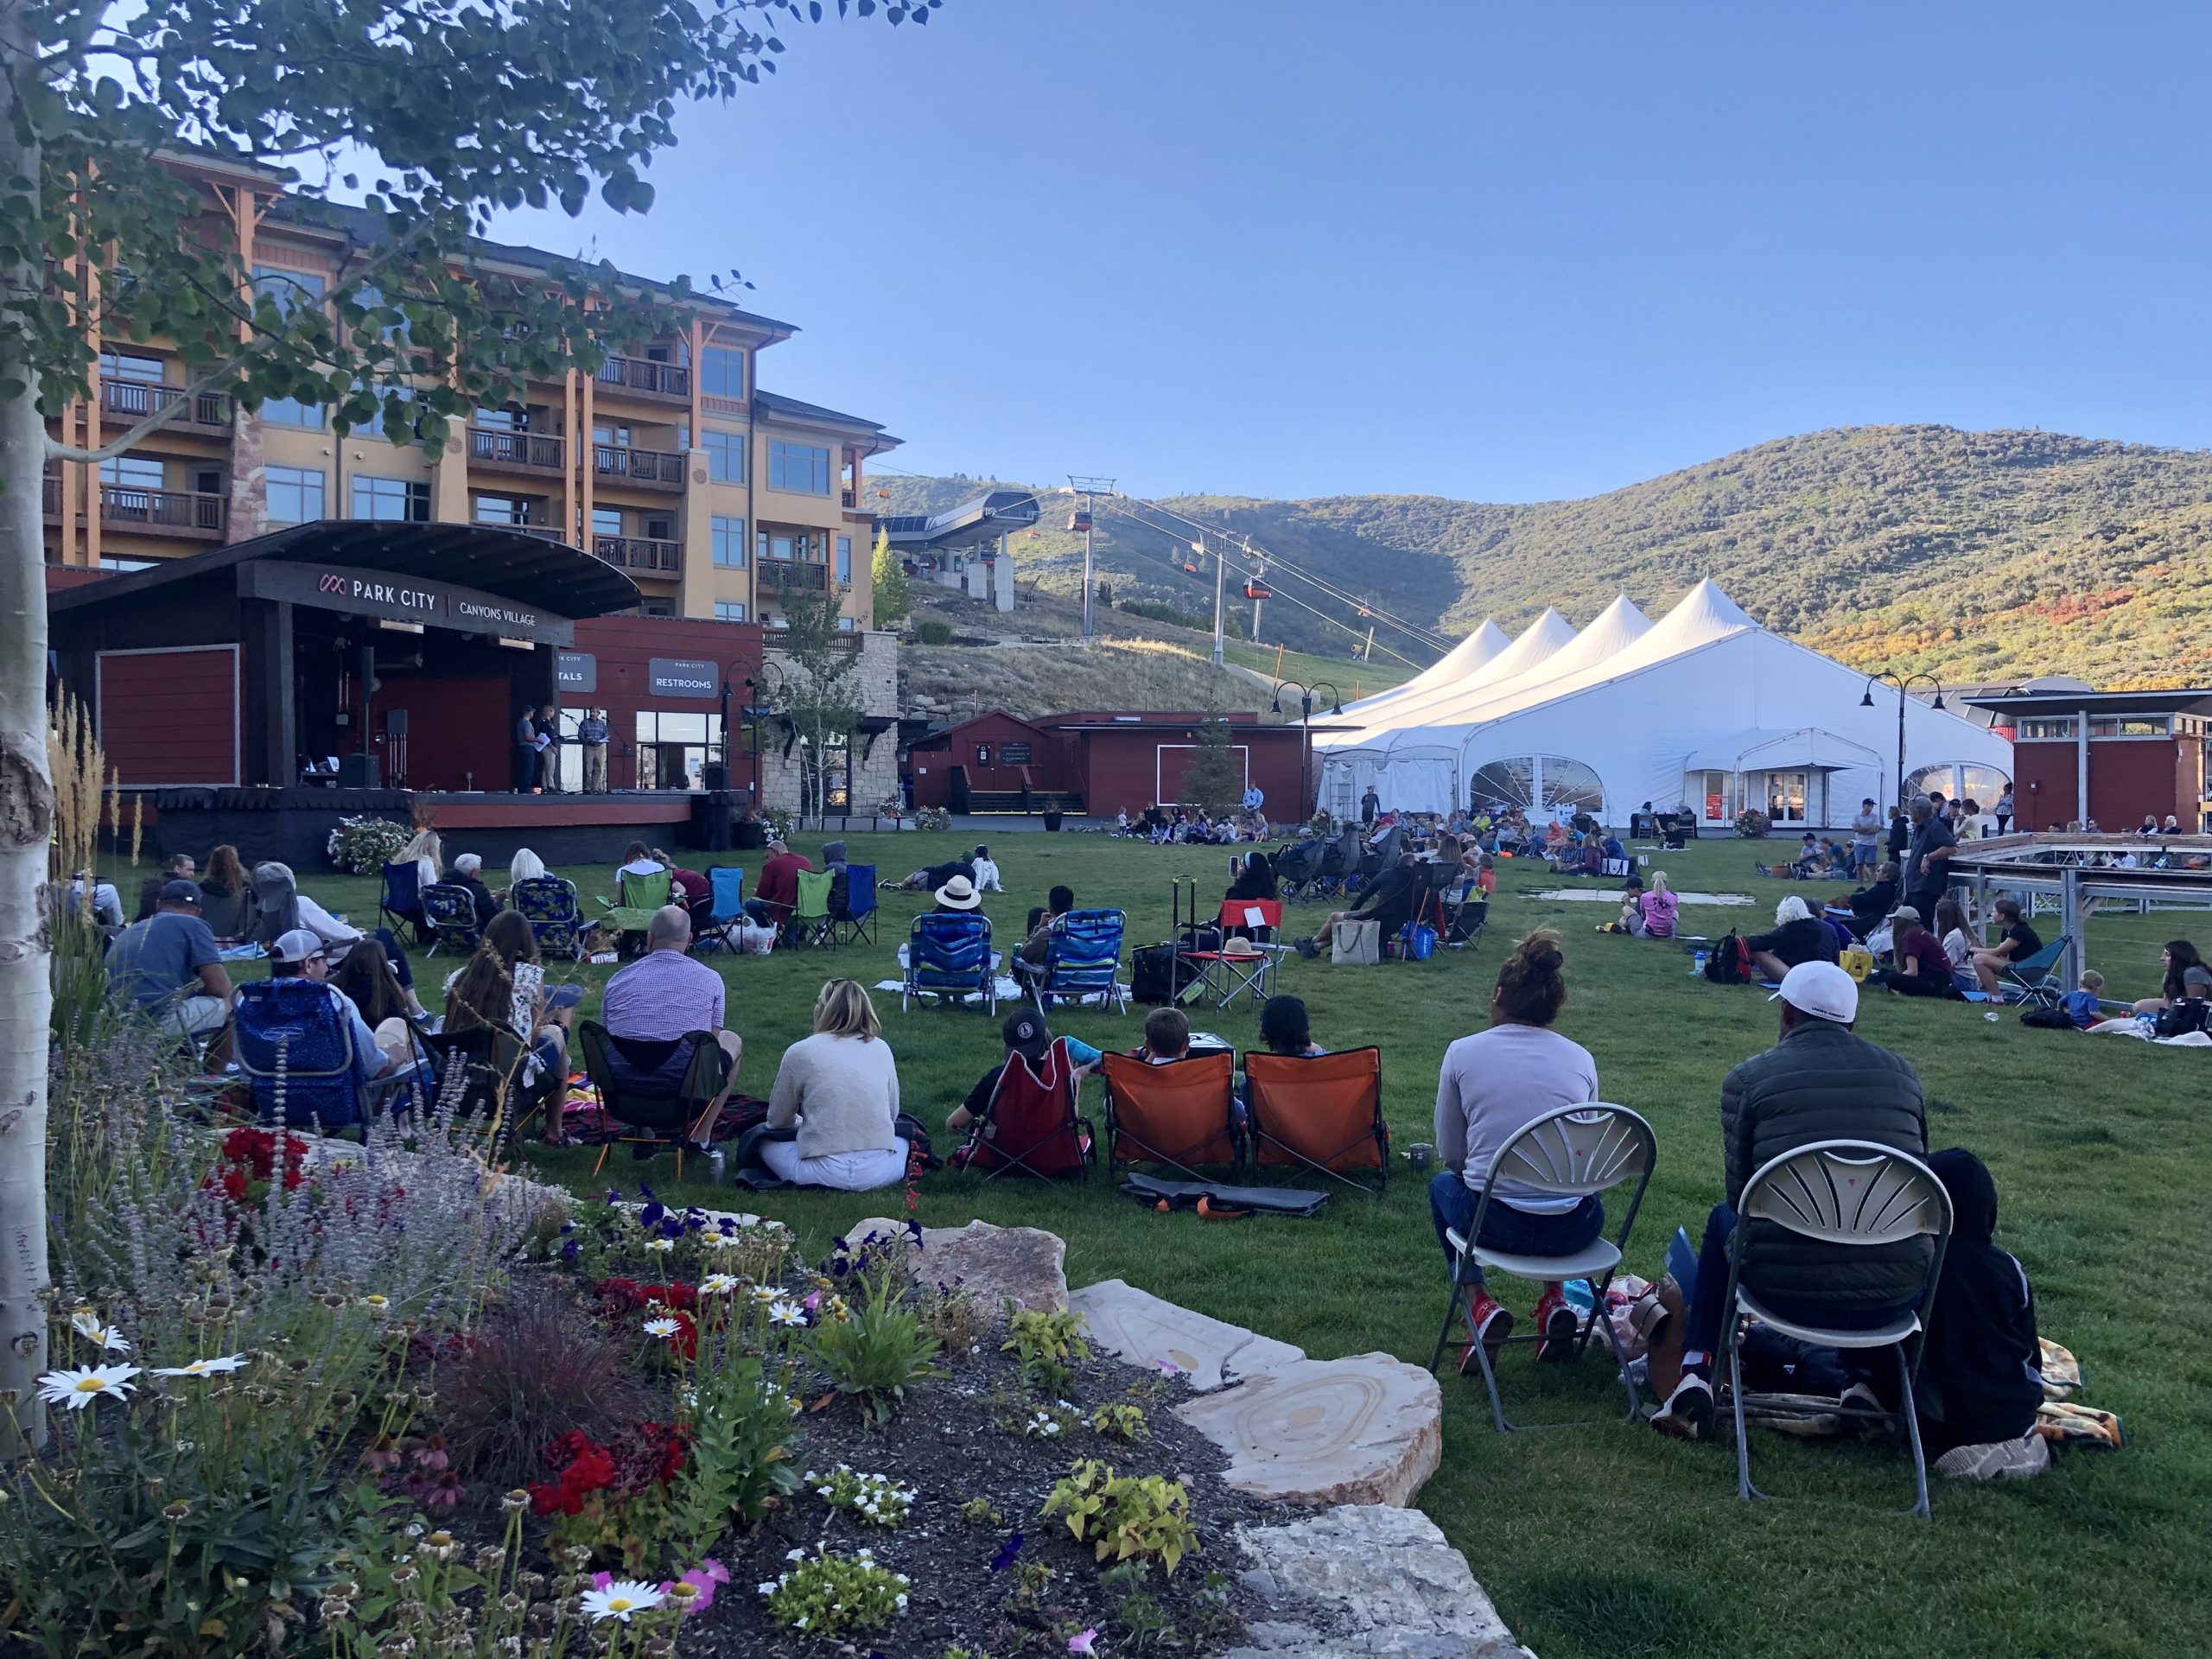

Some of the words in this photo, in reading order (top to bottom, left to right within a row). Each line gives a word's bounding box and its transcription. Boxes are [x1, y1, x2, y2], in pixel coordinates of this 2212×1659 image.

[353, 580, 395, 604] PARK
[400, 589, 435, 610] CITY
[460, 602, 502, 620] CANYONS
[503, 610, 536, 626] VILLAGE
[656, 677, 712, 690] RESTROOMS
